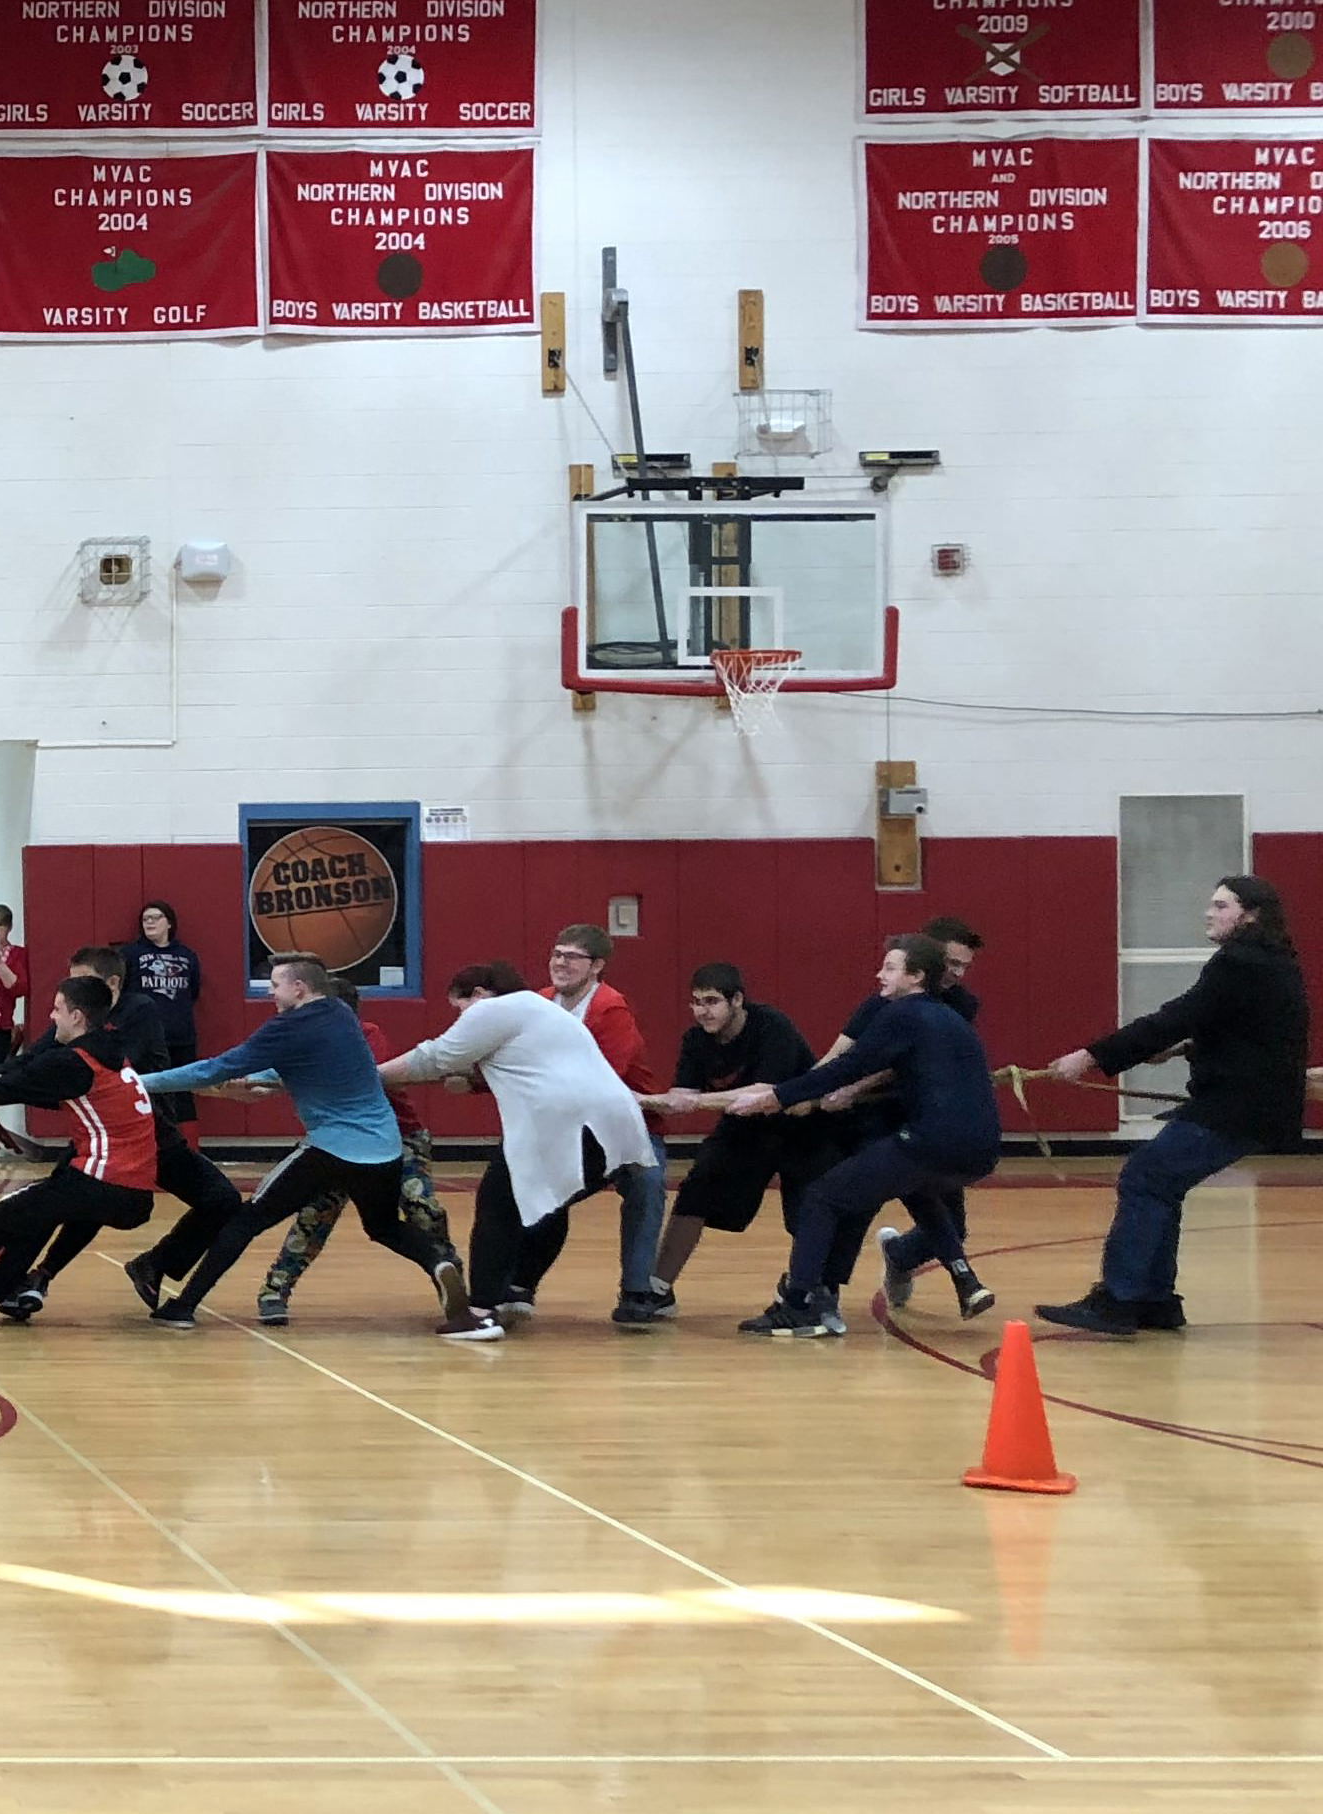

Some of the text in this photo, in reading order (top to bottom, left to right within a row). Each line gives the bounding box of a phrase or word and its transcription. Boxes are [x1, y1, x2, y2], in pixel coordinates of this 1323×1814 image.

[22, 0, 226, 20] NORTHERN DIVISION
[298, 0, 505, 19] NORTHERN DIVISION
[977, 14, 1029, 34] 2009
[1266, 10, 1316, 31] 2010
[56, 23, 193, 44] CHAMPIONS
[332, 23, 470, 43] CHAMPIONS
[868, 84, 1137, 107] GIRLS VARSITY SOFTBALL
[1155, 82, 1294, 103] BOYS VARSITY
[77, 102, 152, 122] VARSITY
[181, 101, 254, 122] SOCCER
[271, 101, 532, 122] GIRLS VARSITY SOCCER
[972, 147, 1033, 168] MVAC
[1255, 146, 1316, 166] MVAC
[93, 164, 152, 183] MVAC
[369, 158, 429, 178] MVAC
[297, 181, 504, 202] NORTHERN DIVISION
[1178, 171, 1282, 191] NORTHERN
[54, 187, 192, 207] CHAMPIONS
[897, 187, 1108, 210] NORTHERN DIVISION
[98, 212, 148, 231] 2004
[330, 206, 470, 226] CHAMPIONS
[932, 211, 1074, 234] CHAMPIONS
[1258, 220, 1312, 239] 2006
[374, 231, 426, 251] 2004
[869, 292, 1134, 314] BOYS VARSITY BASKETBALL
[1149, 288, 1289, 309] BOYS VARSITY
[42, 304, 207, 326] VARSITY GOLF
[272, 299, 530, 321] BOYS VARSITY BASKETBALL
[272, 853, 368, 886] COACH
[255, 876, 393, 915] BRONSON
[141, 976, 189, 989] PATRIOTS
